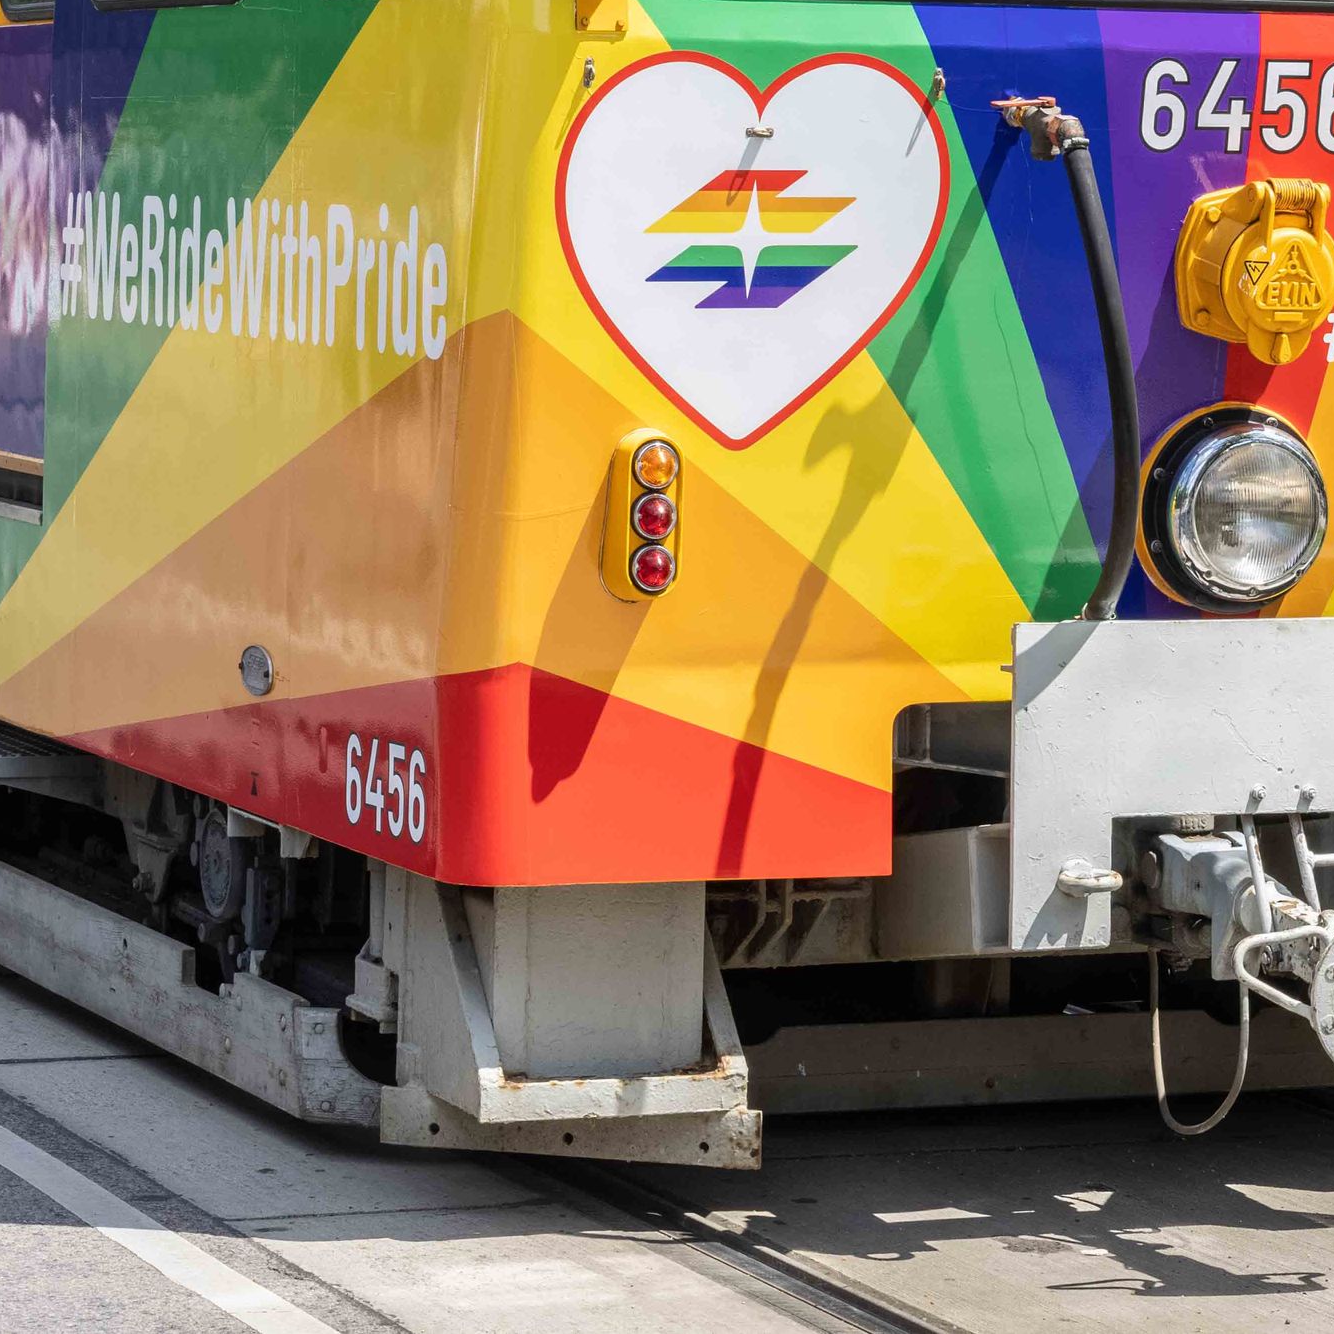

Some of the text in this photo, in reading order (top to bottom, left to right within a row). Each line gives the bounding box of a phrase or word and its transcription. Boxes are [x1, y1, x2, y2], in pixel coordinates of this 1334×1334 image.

[60, 189, 448, 360] #WeRideWithPride
[1267, 281, 1317, 307] ELIN
[344, 732, 428, 845] 6456
